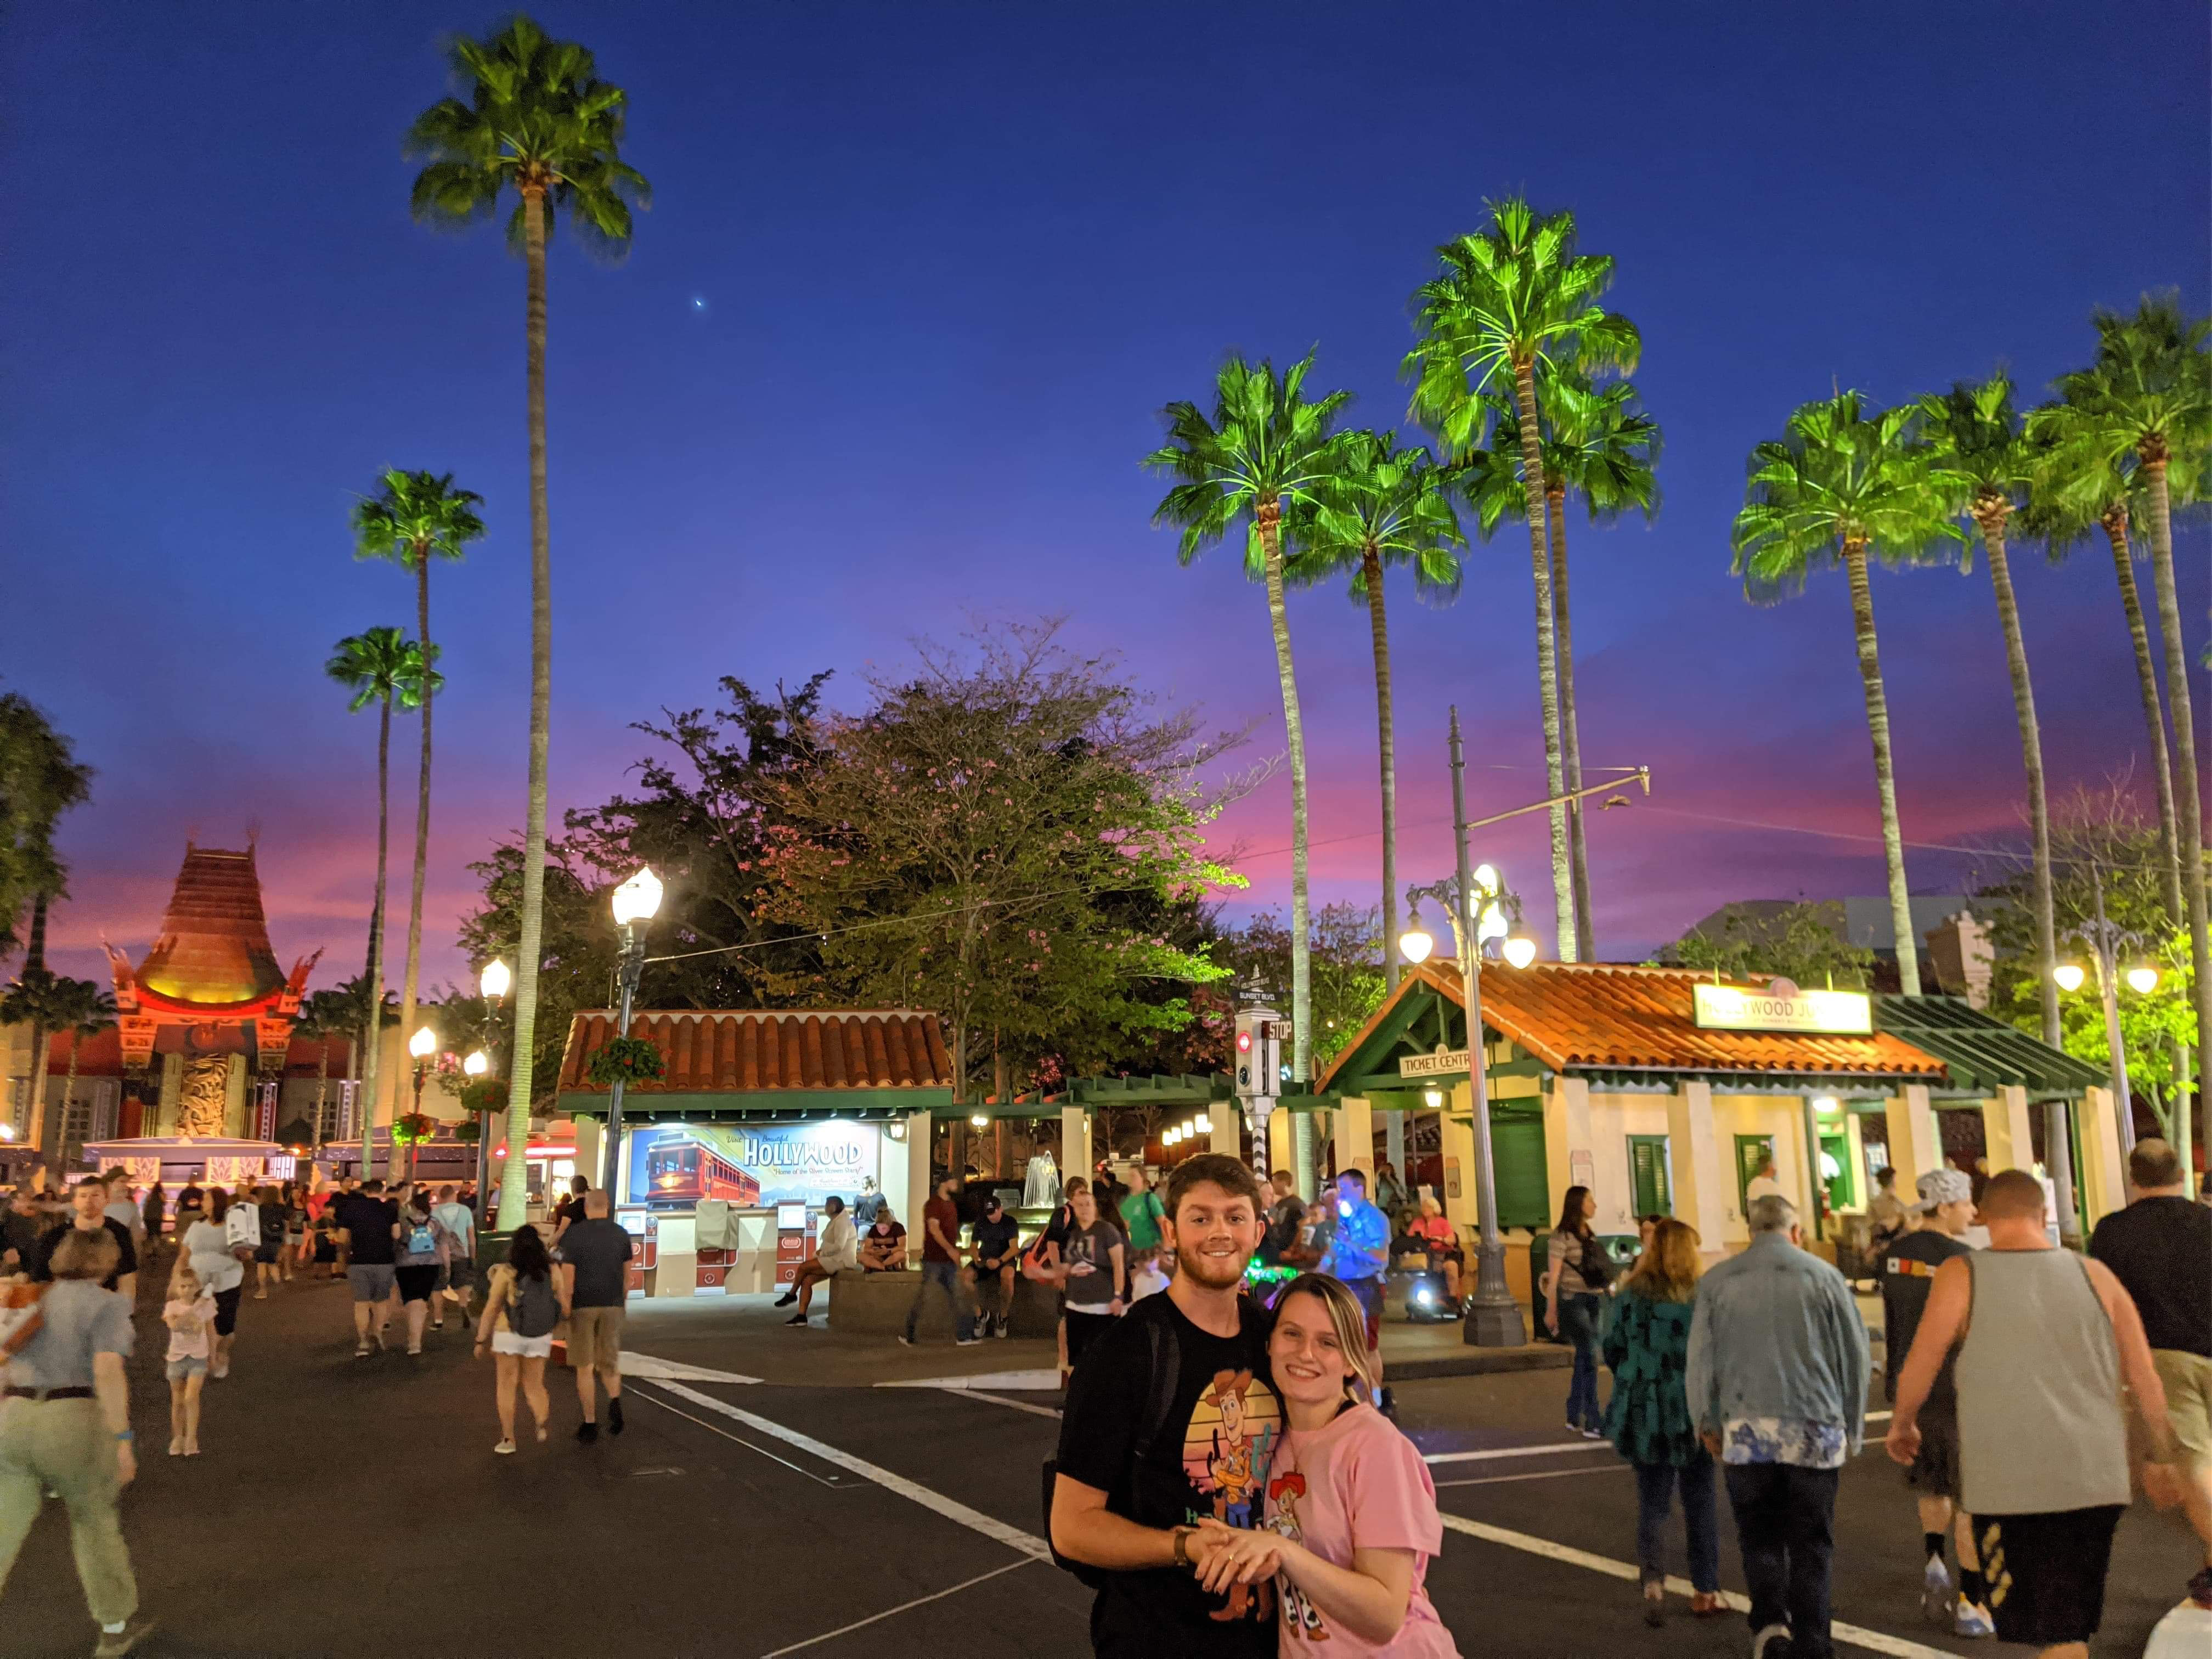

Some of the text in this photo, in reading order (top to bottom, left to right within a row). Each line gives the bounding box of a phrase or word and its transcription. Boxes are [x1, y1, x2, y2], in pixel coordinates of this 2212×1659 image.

[1703, 1000, 1794, 1017] HYWOOD
[1269, 1021, 1292, 1039] STOP
[1405, 1057, 1437, 1071] TICKET
[1440, 1054, 1470, 1068] CENTR
[762, 1135, 788, 1144] Beautiful
[743, 1138, 863, 1166] HOLLYWOOD
